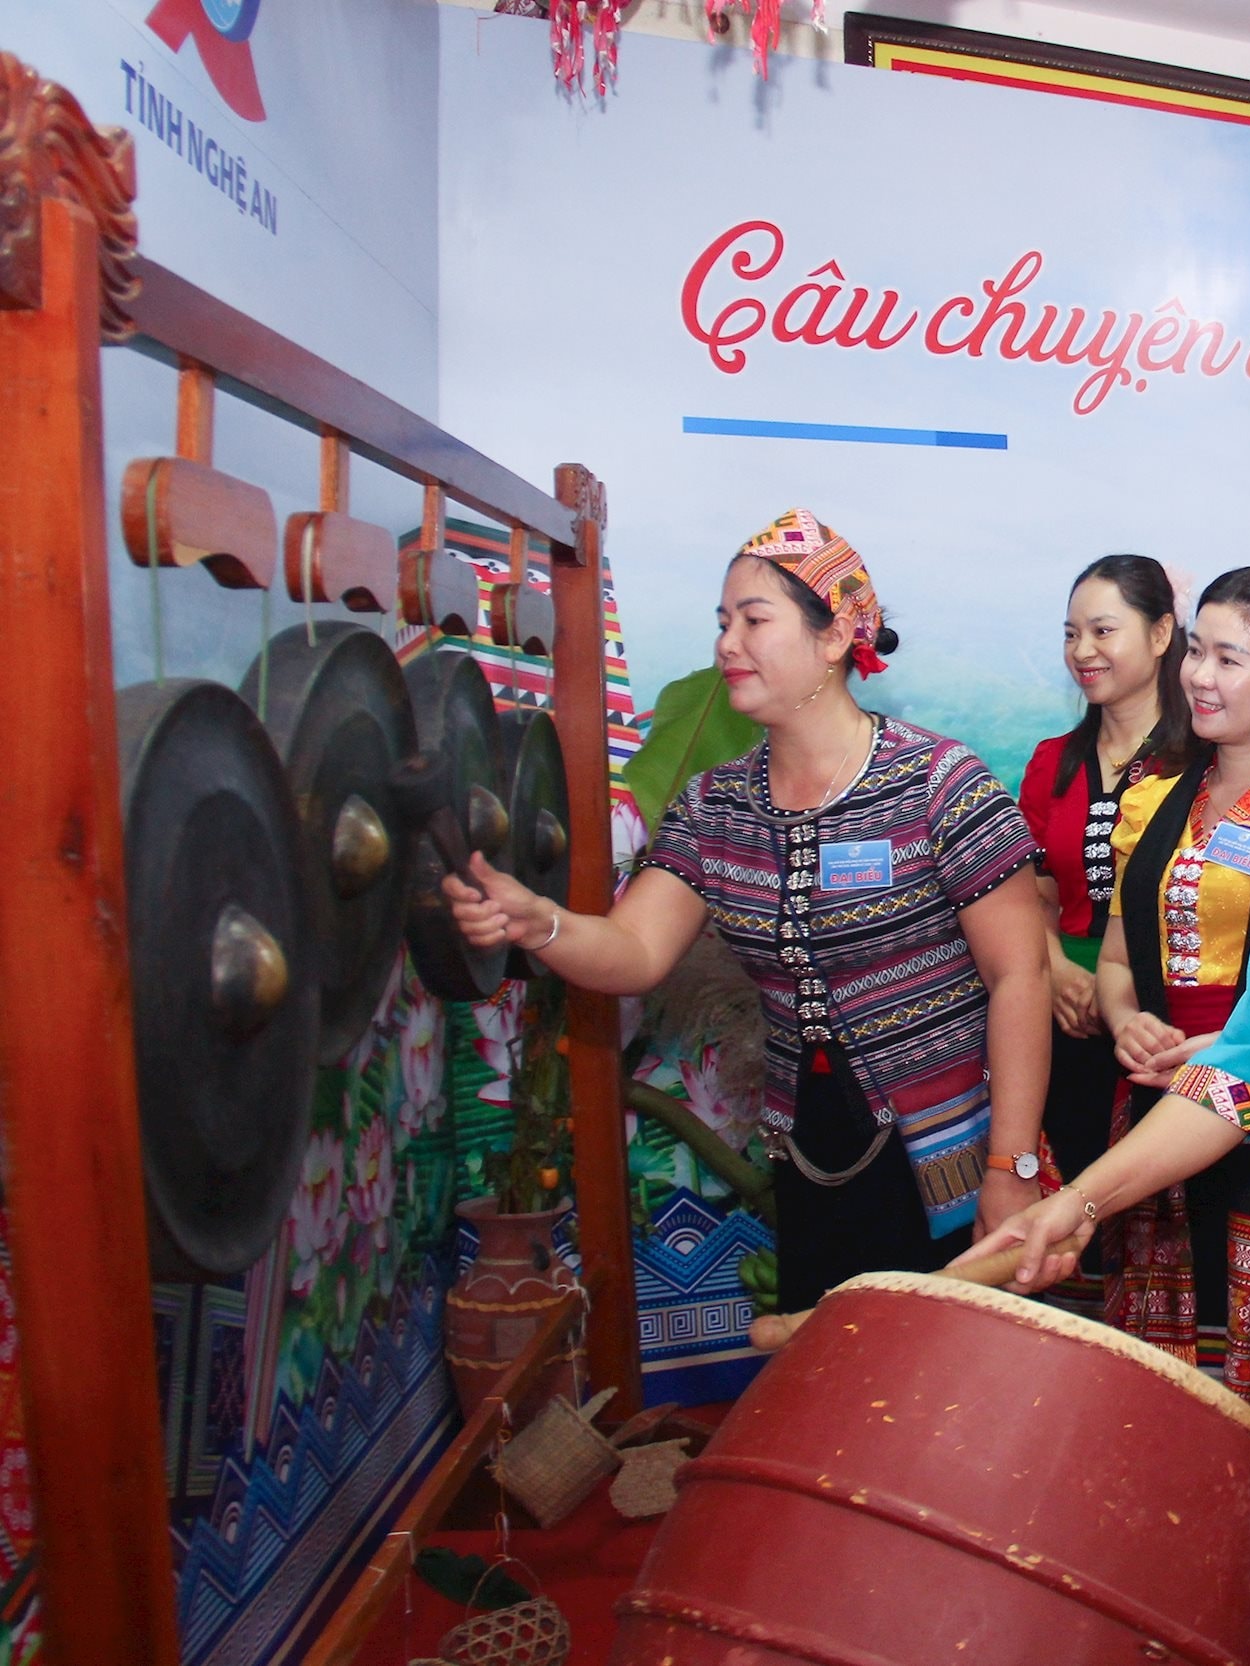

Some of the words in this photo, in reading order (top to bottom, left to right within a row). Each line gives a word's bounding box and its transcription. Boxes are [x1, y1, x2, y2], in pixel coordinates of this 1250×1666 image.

[120, 58, 183, 157] TỈNH
[187, 119, 247, 215] NGHỆ
[250, 179, 277, 235] AN
[681, 219, 918, 374] Câu
[924, 251, 1241, 415] chuyện
[829, 872, 853, 886] ĐẠI
[855, 865, 883, 883] BIỂU
[1211, 847, 1231, 861] ĐẠI
